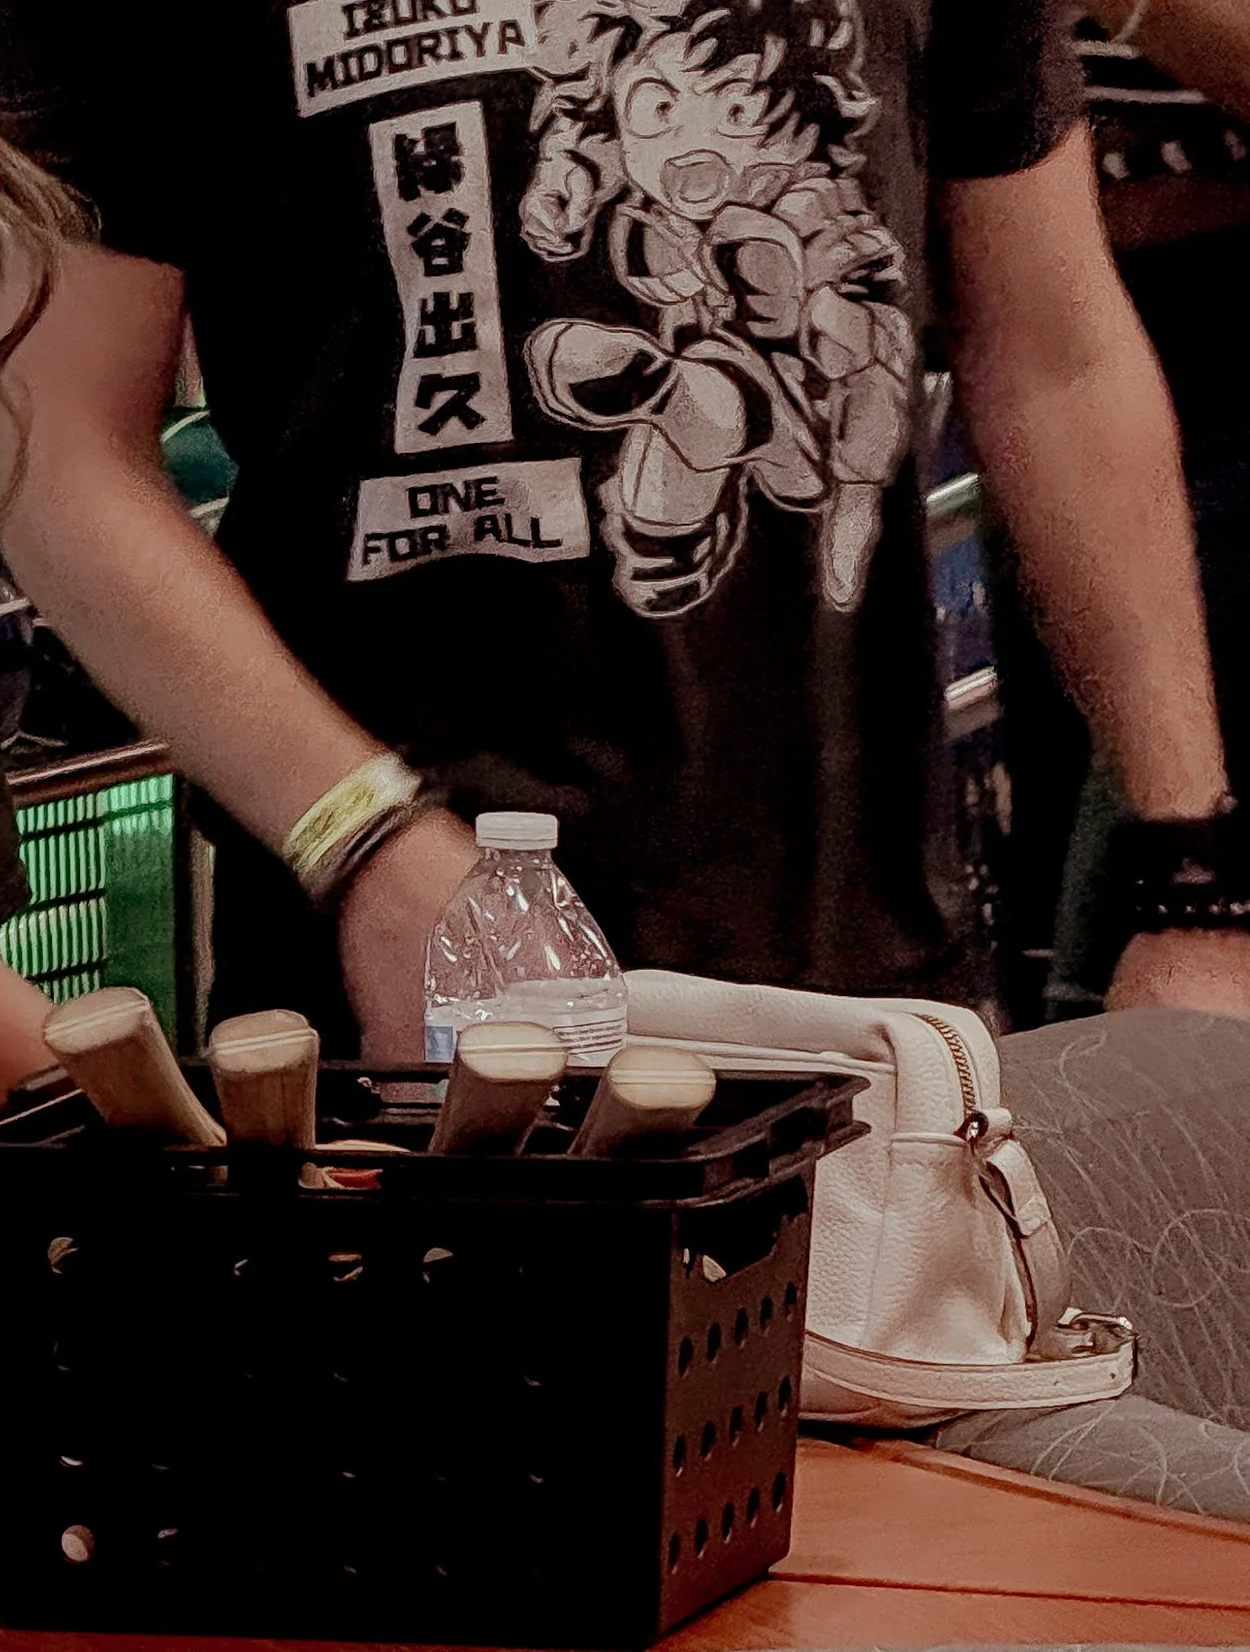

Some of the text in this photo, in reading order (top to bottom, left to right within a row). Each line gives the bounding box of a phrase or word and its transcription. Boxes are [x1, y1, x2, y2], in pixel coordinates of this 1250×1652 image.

[305, 19, 526, 97] MIDORIYA
[406, 476, 506, 518] ONE
[362, 512, 564, 566] FOR ALL
